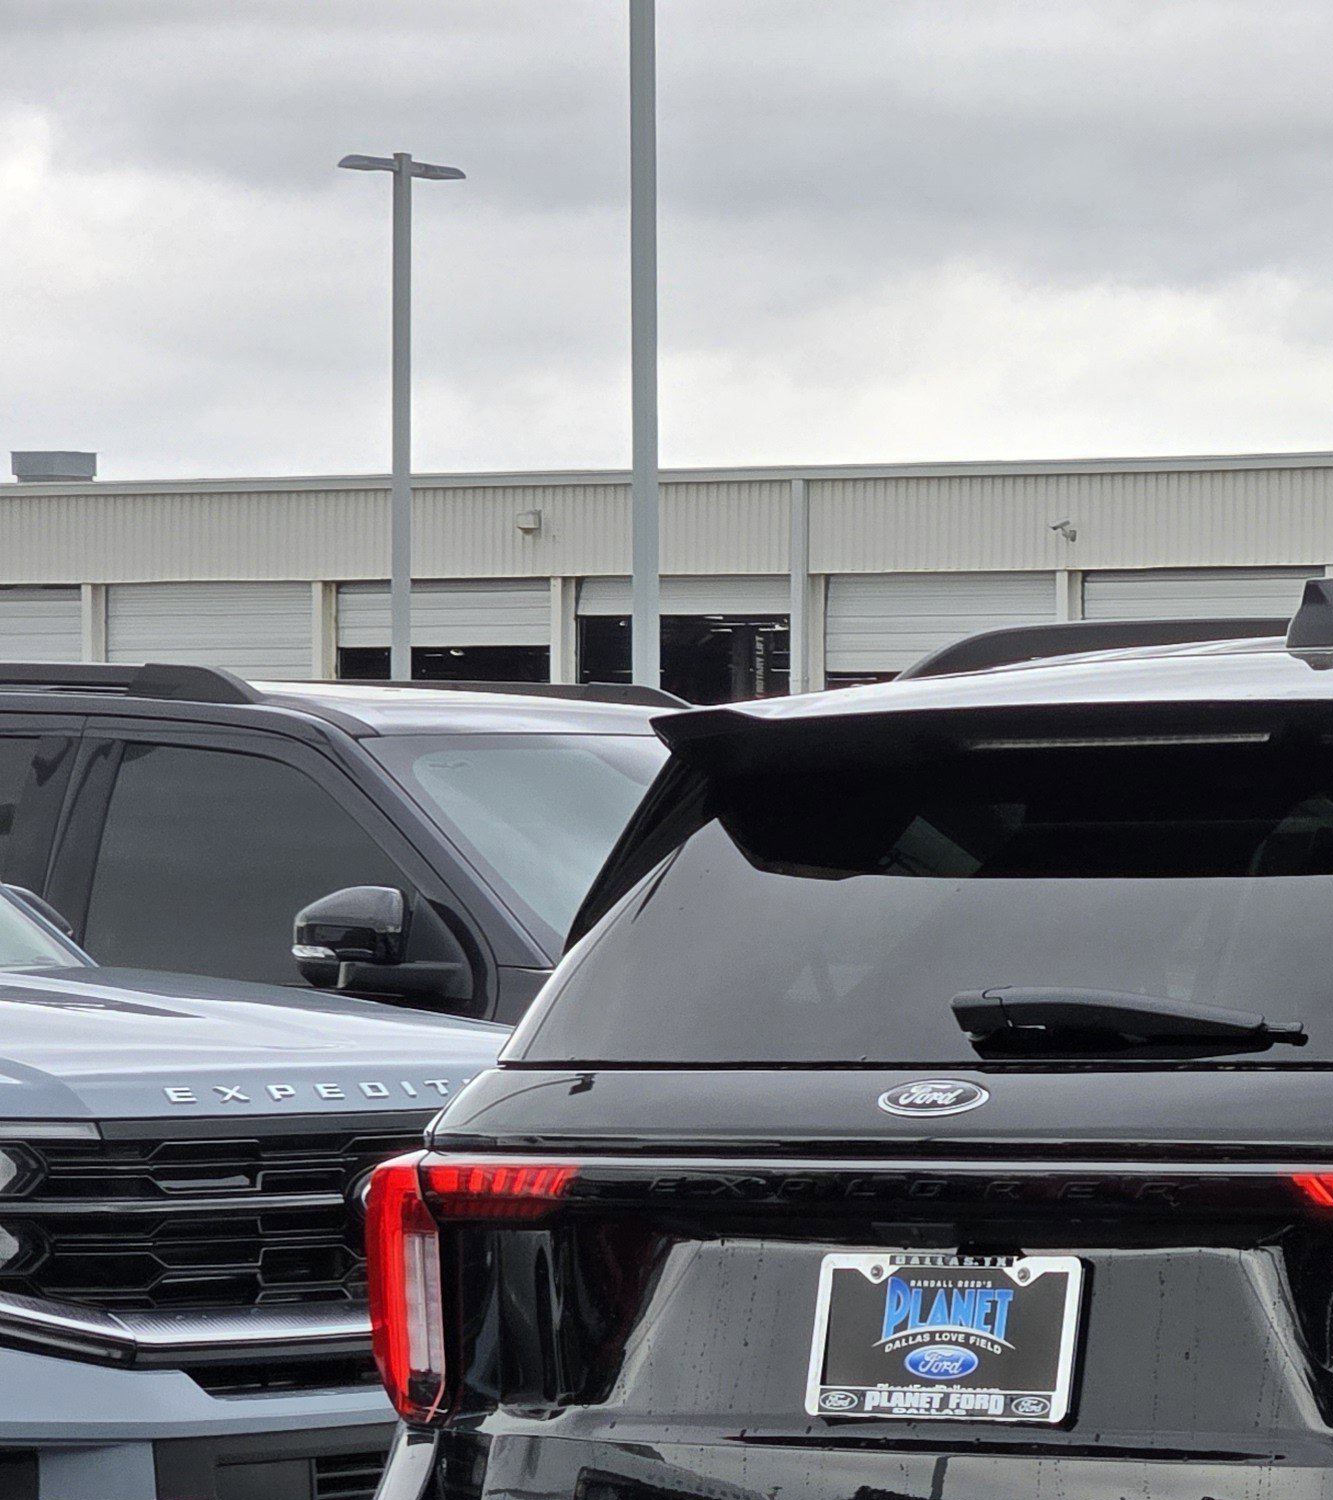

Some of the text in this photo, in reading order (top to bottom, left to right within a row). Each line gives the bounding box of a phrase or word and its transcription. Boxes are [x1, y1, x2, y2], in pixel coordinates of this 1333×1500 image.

[164, 1077, 470, 1102] EXPEDIT
[910, 1279, 953, 1288] RANDALL
[881, 1276, 1014, 1341] PLANET
[884, 1331, 1003, 1355] DALLAS LOVE FIELD
[916, 1347, 967, 1375] Ford
[863, 1391, 1004, 1415] PLANET FORD
[892, 1407, 967, 1415] DALLAS
